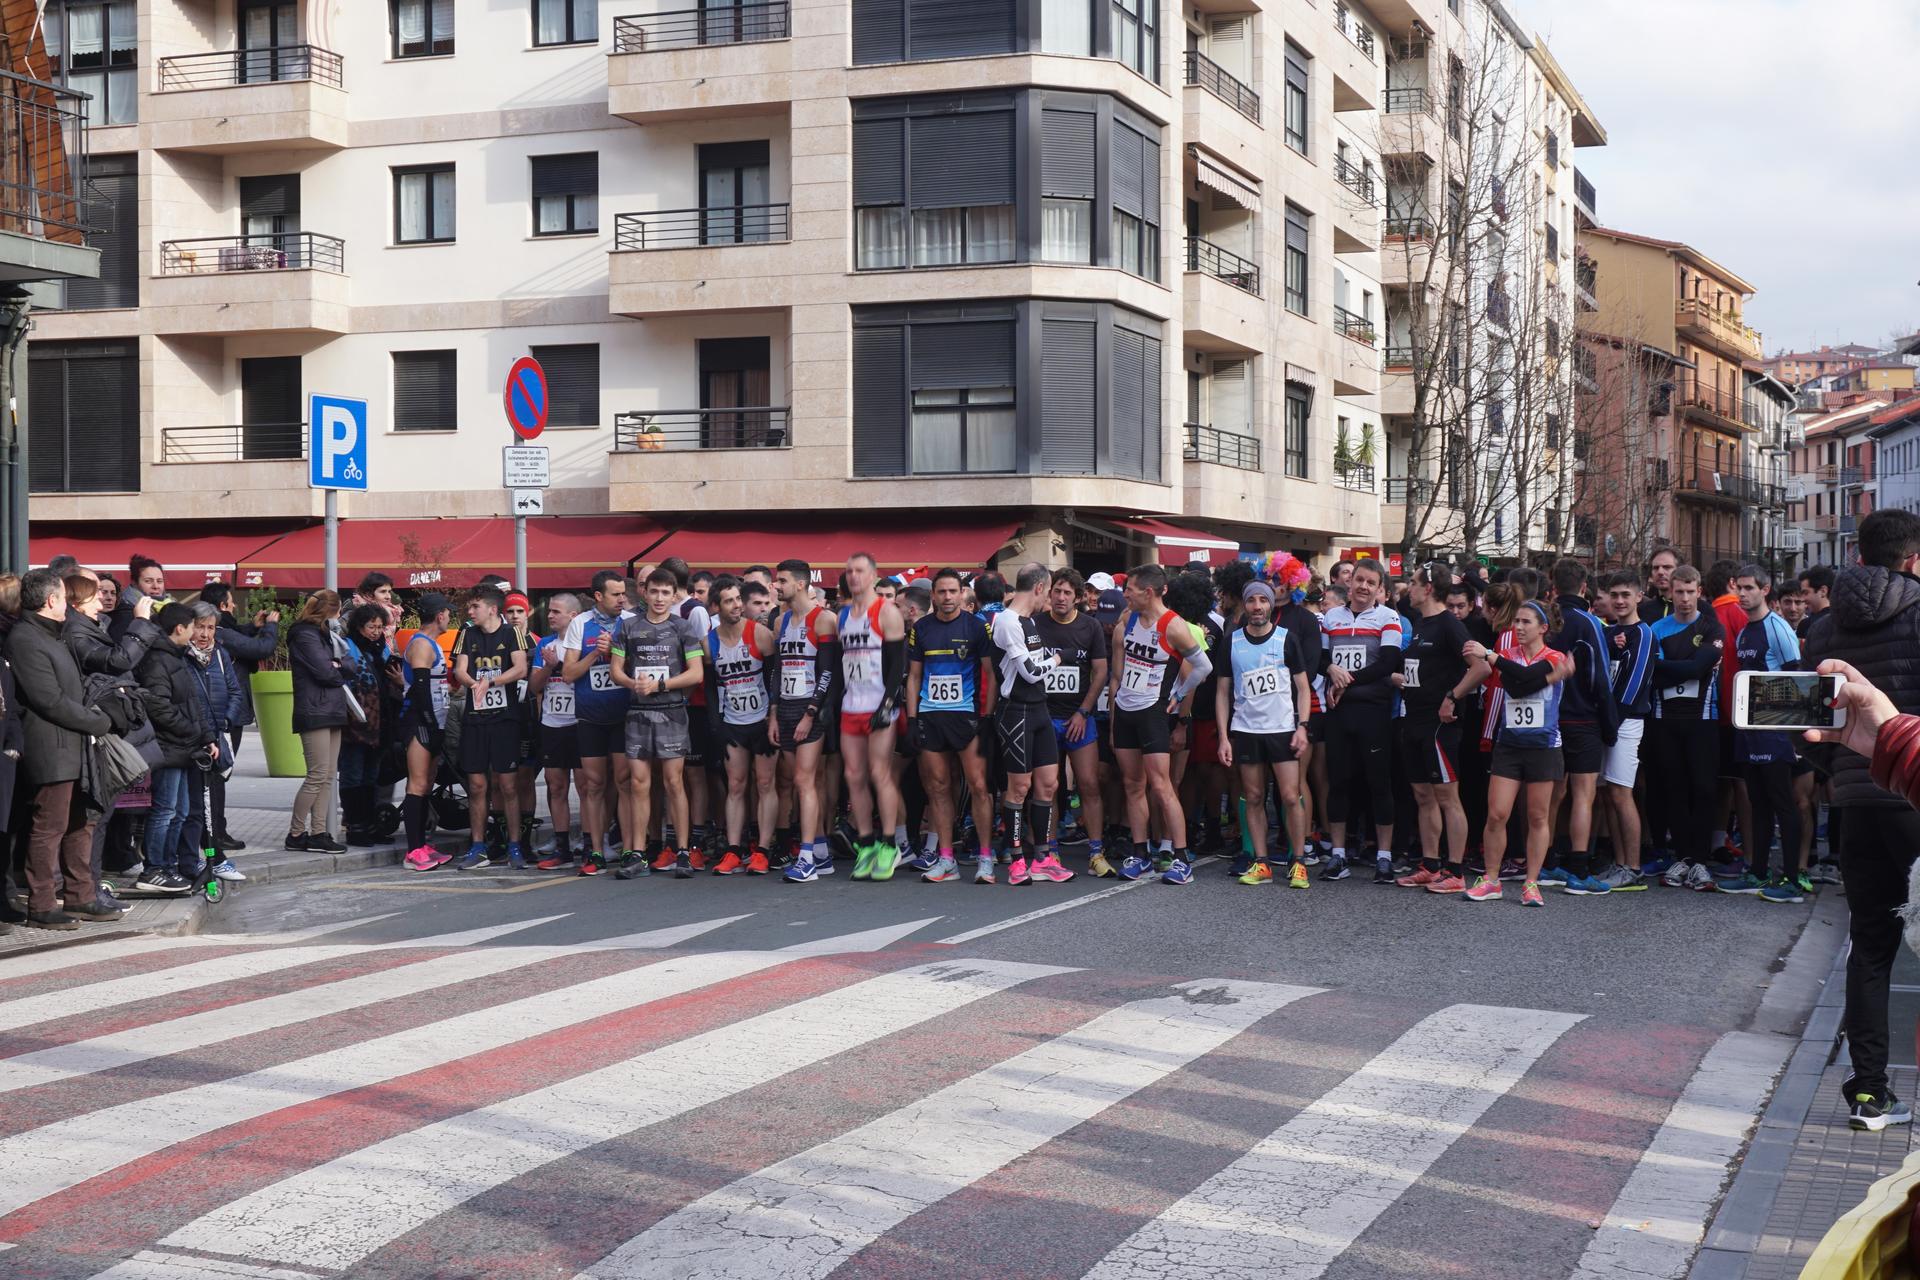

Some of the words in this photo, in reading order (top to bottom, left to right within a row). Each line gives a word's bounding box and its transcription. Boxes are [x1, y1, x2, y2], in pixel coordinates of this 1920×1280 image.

[322, 405, 357, 478] P
[1125, 639, 1158, 659] ZMT
[718, 660, 752, 675] ZMT
[1335, 652, 1362, 669] 218
[783, 677, 797, 694] 27
[1046, 673, 1076, 691] 260
[1126, 670, 1141, 689] 17
[1248, 673, 1276, 695] 129
[483, 689, 503, 706] 63
[931, 682, 959, 700] 265
[549, 696, 572, 712] 157
[731, 695, 758, 711] 370
[1514, 706, 1534, 725] 39
